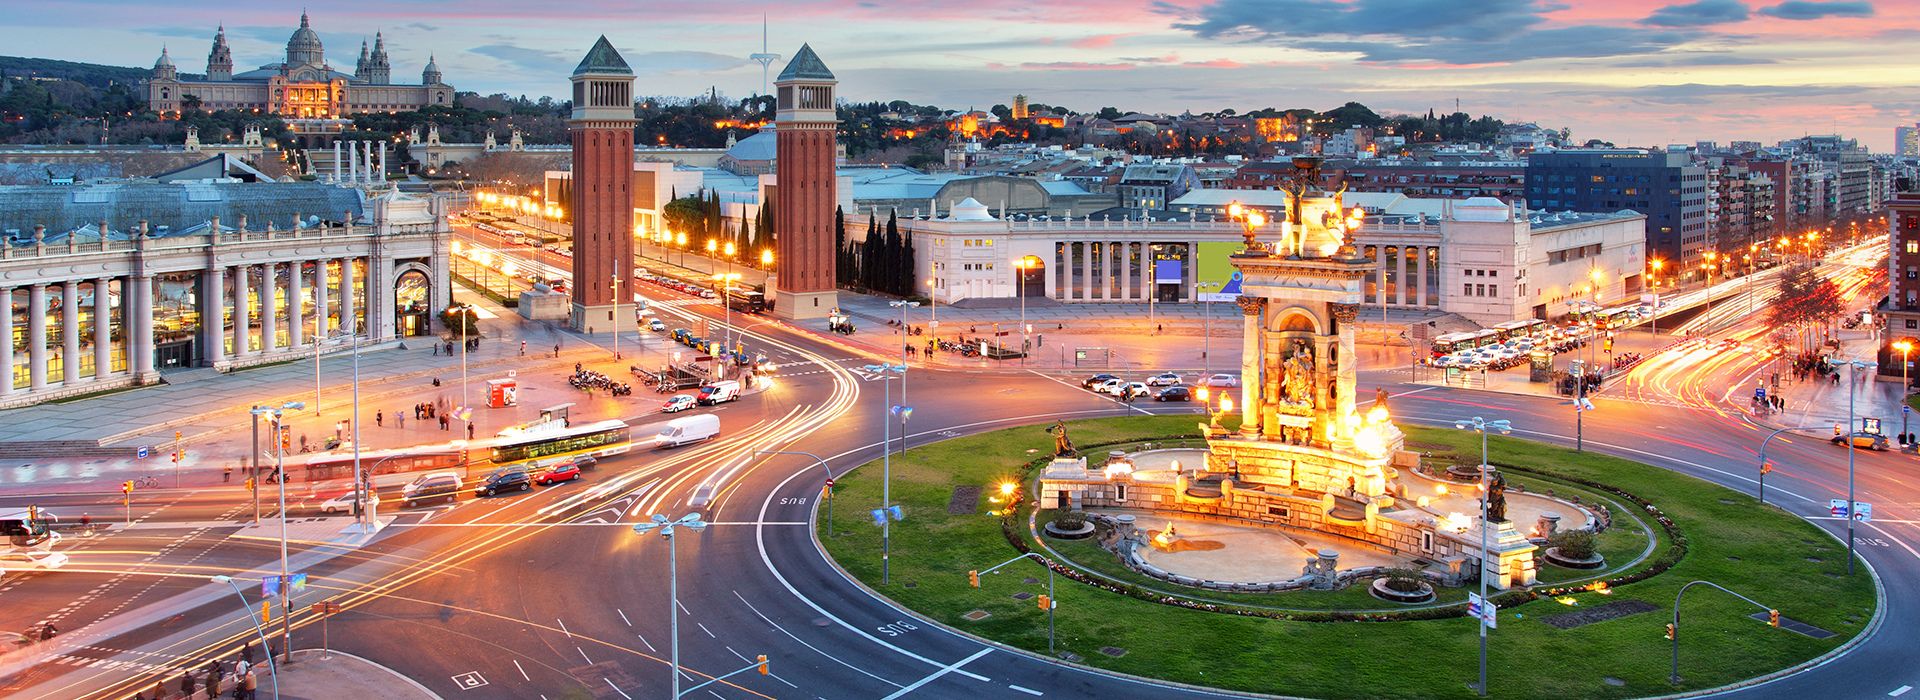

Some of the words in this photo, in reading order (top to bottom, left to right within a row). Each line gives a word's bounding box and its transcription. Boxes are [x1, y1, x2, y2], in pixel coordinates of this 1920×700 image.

[780, 497, 807, 505] BUS
[1853, 537, 1889, 547] BUS
[877, 620, 919, 636] BUS
[465, 674, 479, 686] P
